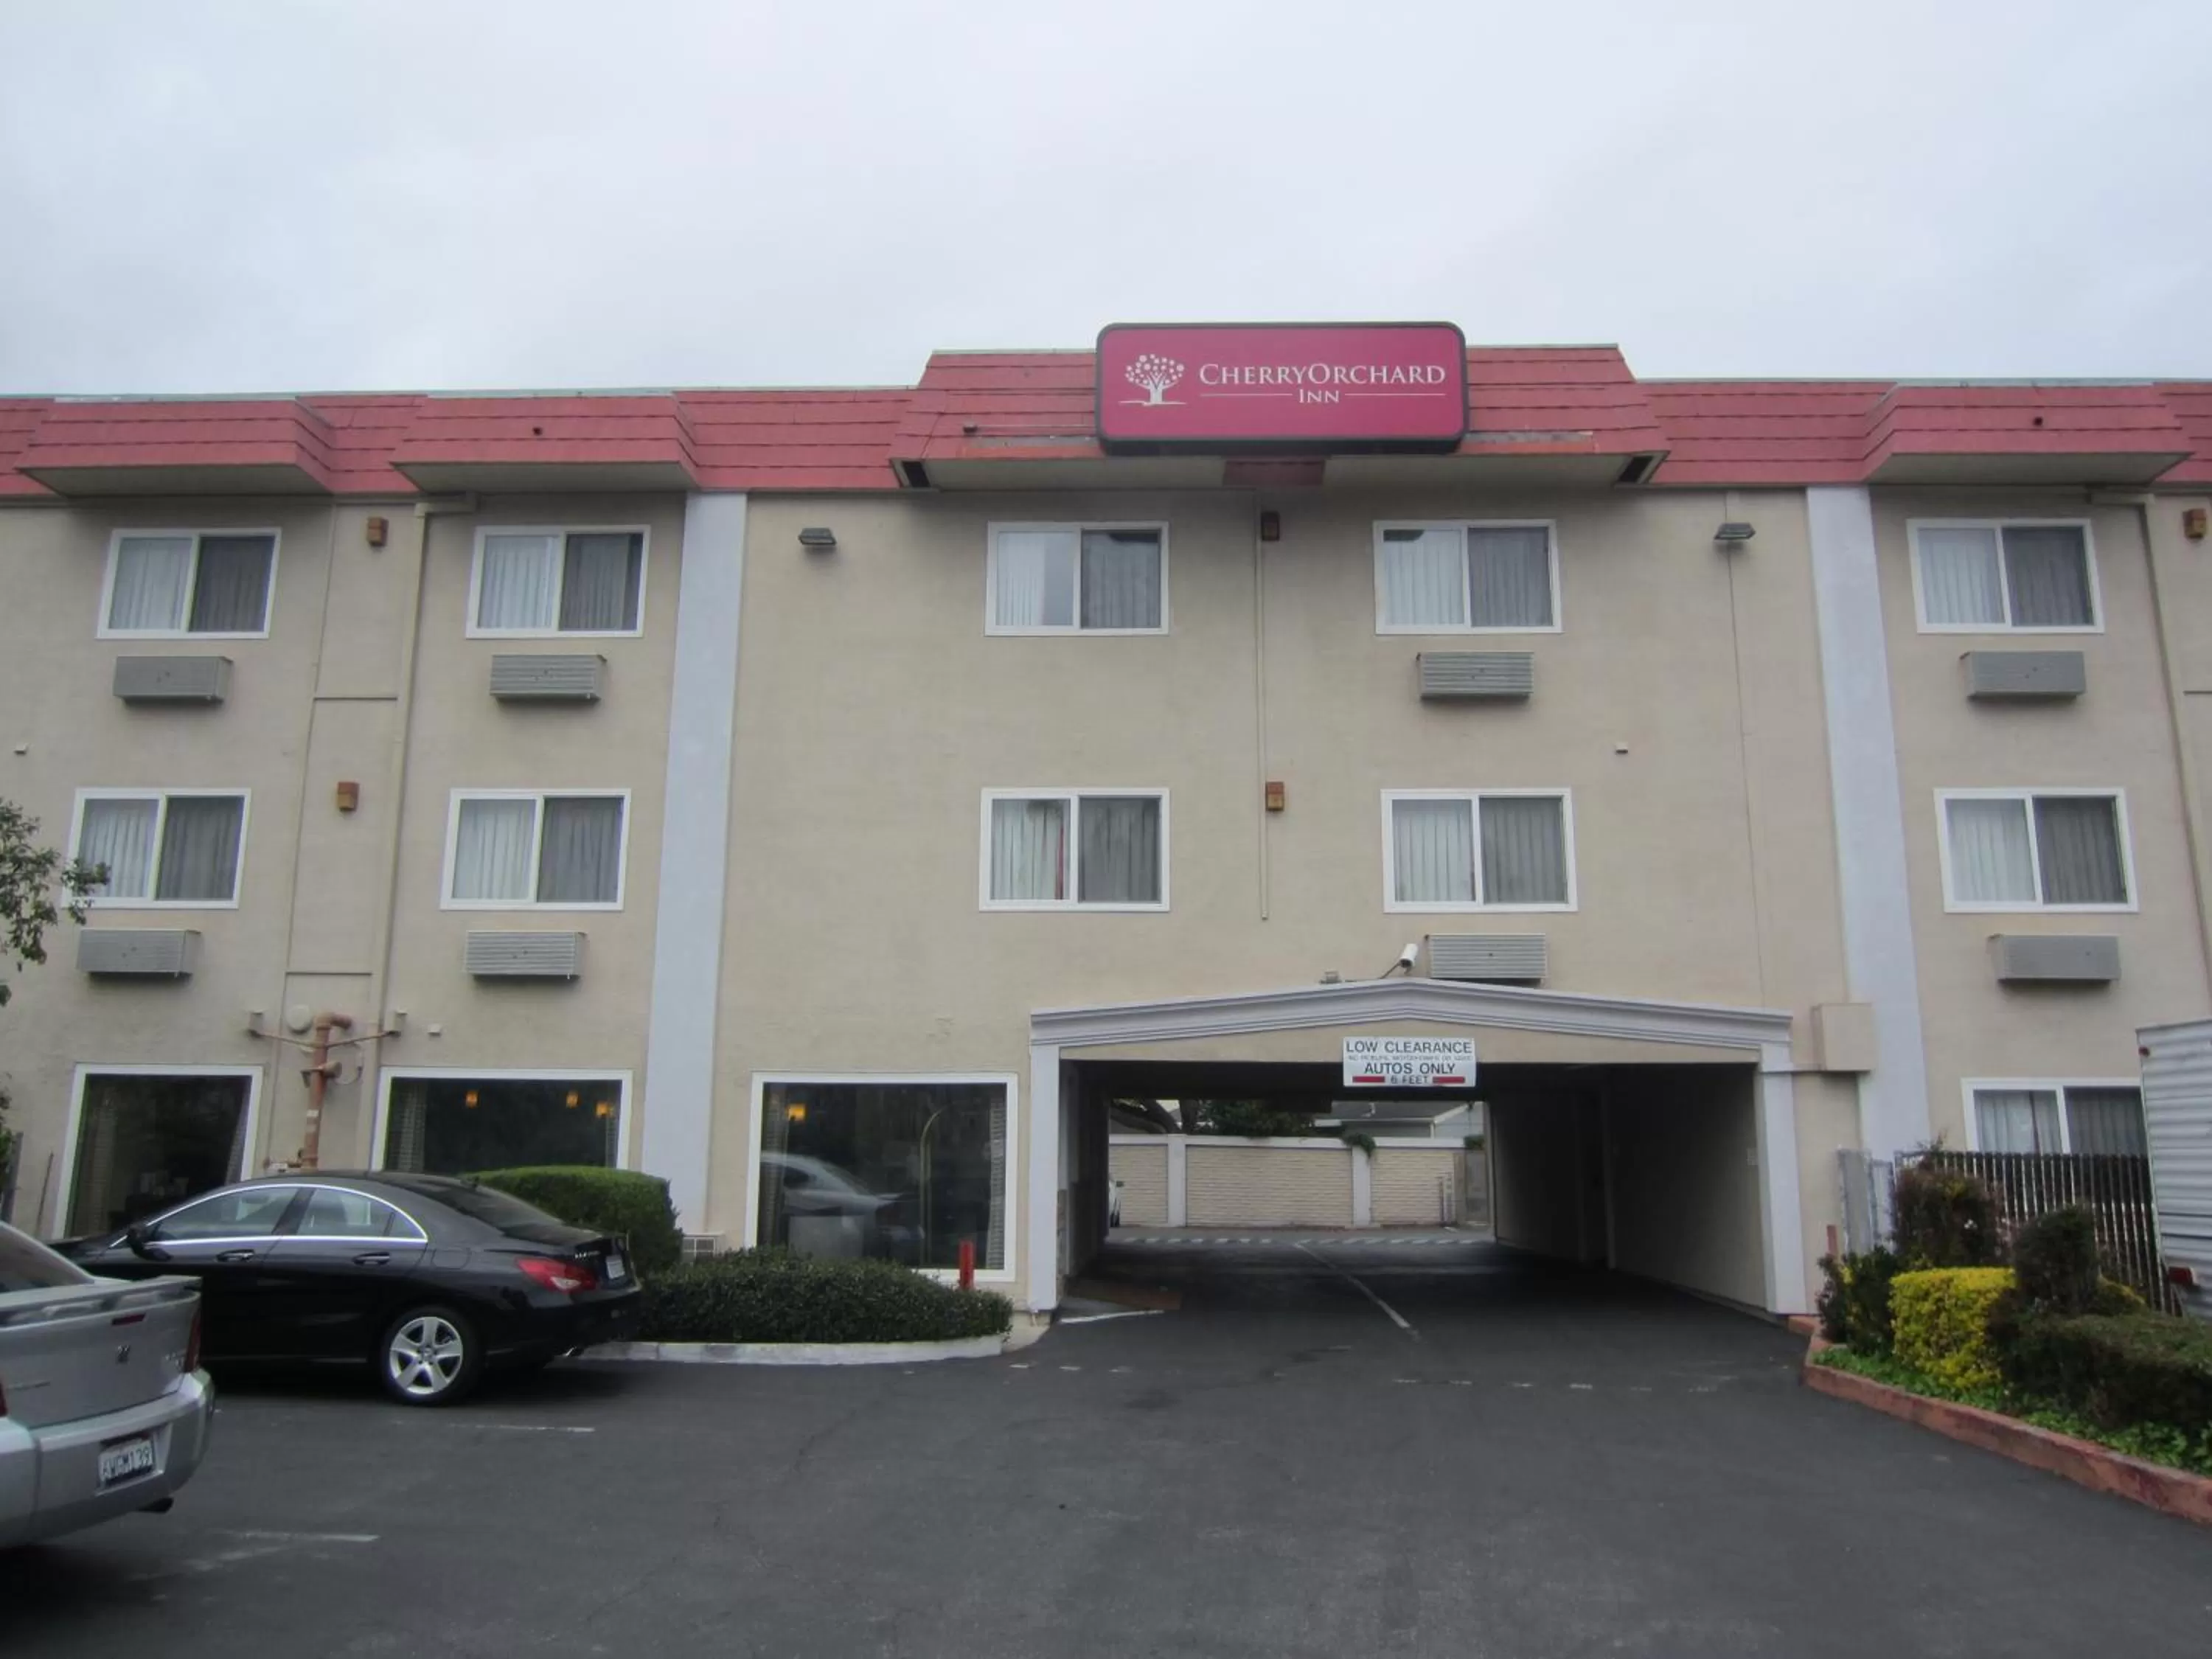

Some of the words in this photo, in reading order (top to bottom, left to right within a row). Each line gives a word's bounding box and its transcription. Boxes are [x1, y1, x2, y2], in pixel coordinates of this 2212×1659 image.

[1298, 389, 1340, 403] INN
[1346, 1040, 1378, 1053] LOW
[1384, 1040, 1472, 1054] CLEARANCE
[1364, 1062, 1413, 1074] AUTOS
[1419, 1062, 1455, 1074] ONLY
[1402, 1075, 1428, 1085] FEET
